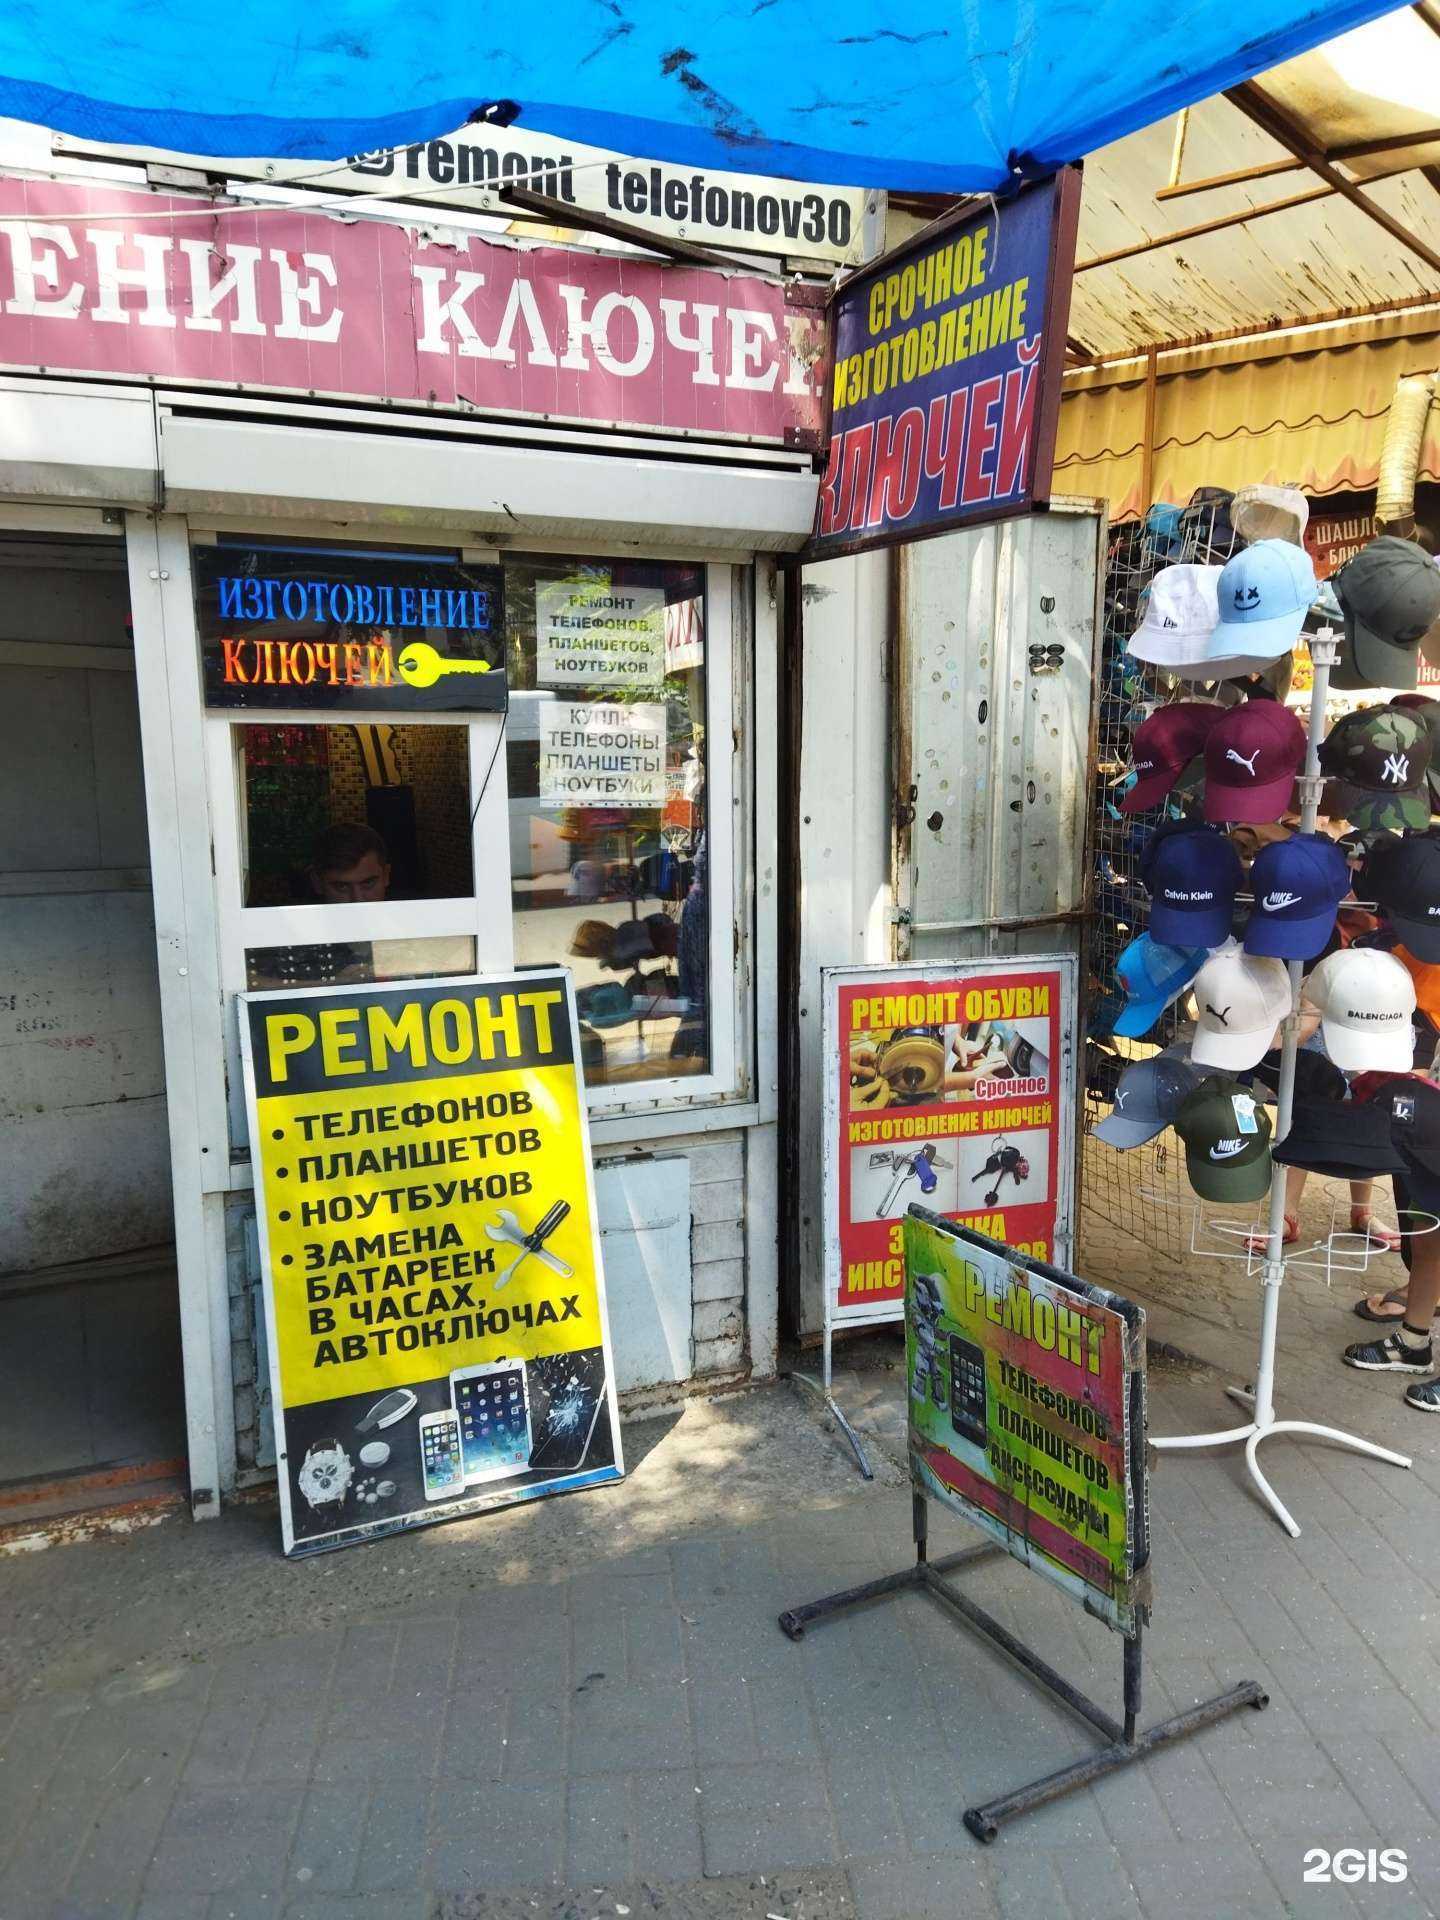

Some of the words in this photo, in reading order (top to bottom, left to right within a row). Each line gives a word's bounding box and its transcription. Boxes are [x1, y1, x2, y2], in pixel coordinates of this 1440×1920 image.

[606, 163, 852, 248] telefonov30
[0, 221, 344, 343] ЕНИЕ
[868, 226, 988, 336] СРОЧНОЕ
[833, 276, 1029, 412] ИЗГОТОВЛЕНИЕ
[814, 333, 1041, 537] КЛЮЧЕЙ
[217, 577, 490, 630] ИЗГОТОВЛЕНИЕ
[569, 594, 635, 610] РЕМОНТ
[220, 635, 393, 688] КЛЮЧЕЙ
[548, 637, 654, 656] ПЛАНШЕТОВ,
[555, 658, 648, 674] НОУТБУКОВ
[547, 754, 660, 772] ПЛАНШЕТЫ
[548, 731, 659, 750] ТЕЛЕФОНЫ
[554, 777, 653, 794] НОУТБУКИ
[1164, 888, 1189, 901] Calvin
[1190, 890, 1214, 901] Klein
[1269, 891, 1293, 904] NIKE
[852, 992, 960, 1030] РЕМОНТ
[965, 985, 1050, 1022] ОБУВИ
[1347, 1009, 1404, 1022] BALENCIAGA
[265, 991, 563, 1083] РЕМОНТ
[975, 1076, 1047, 1100] Срочное
[294, 1090, 534, 1142] ТЕЛЕФОНОВ
[848, 1111, 979, 1143] ИЗГОТОВЛЕНИЕ
[983, 1101, 1052, 1130] КЛЮЧЕЙ
[298, 1127, 542, 1183] ПЛАНШЕТОВ
[1217, 1138, 1242, 1152] NIKE
[301, 1171, 533, 1227] НОУТБУКОВ
[304, 1223, 464, 1271] ЗАМЕНА
[306, 1248, 496, 1303] БАТАРЕЕК
[309, 1307, 336, 1336] В
[350, 1283, 487, 1326] ЧАСАХ,
[313, 1294, 583, 1369] АВТОКЛЮЧАХ
[964, 1259, 1105, 1377] РЕМОНТ
[998, 1359, 1109, 1442] ТЕЛЕФОНОВ
[998, 1401, 1110, 1491] ПЛАНШЕТОВ
